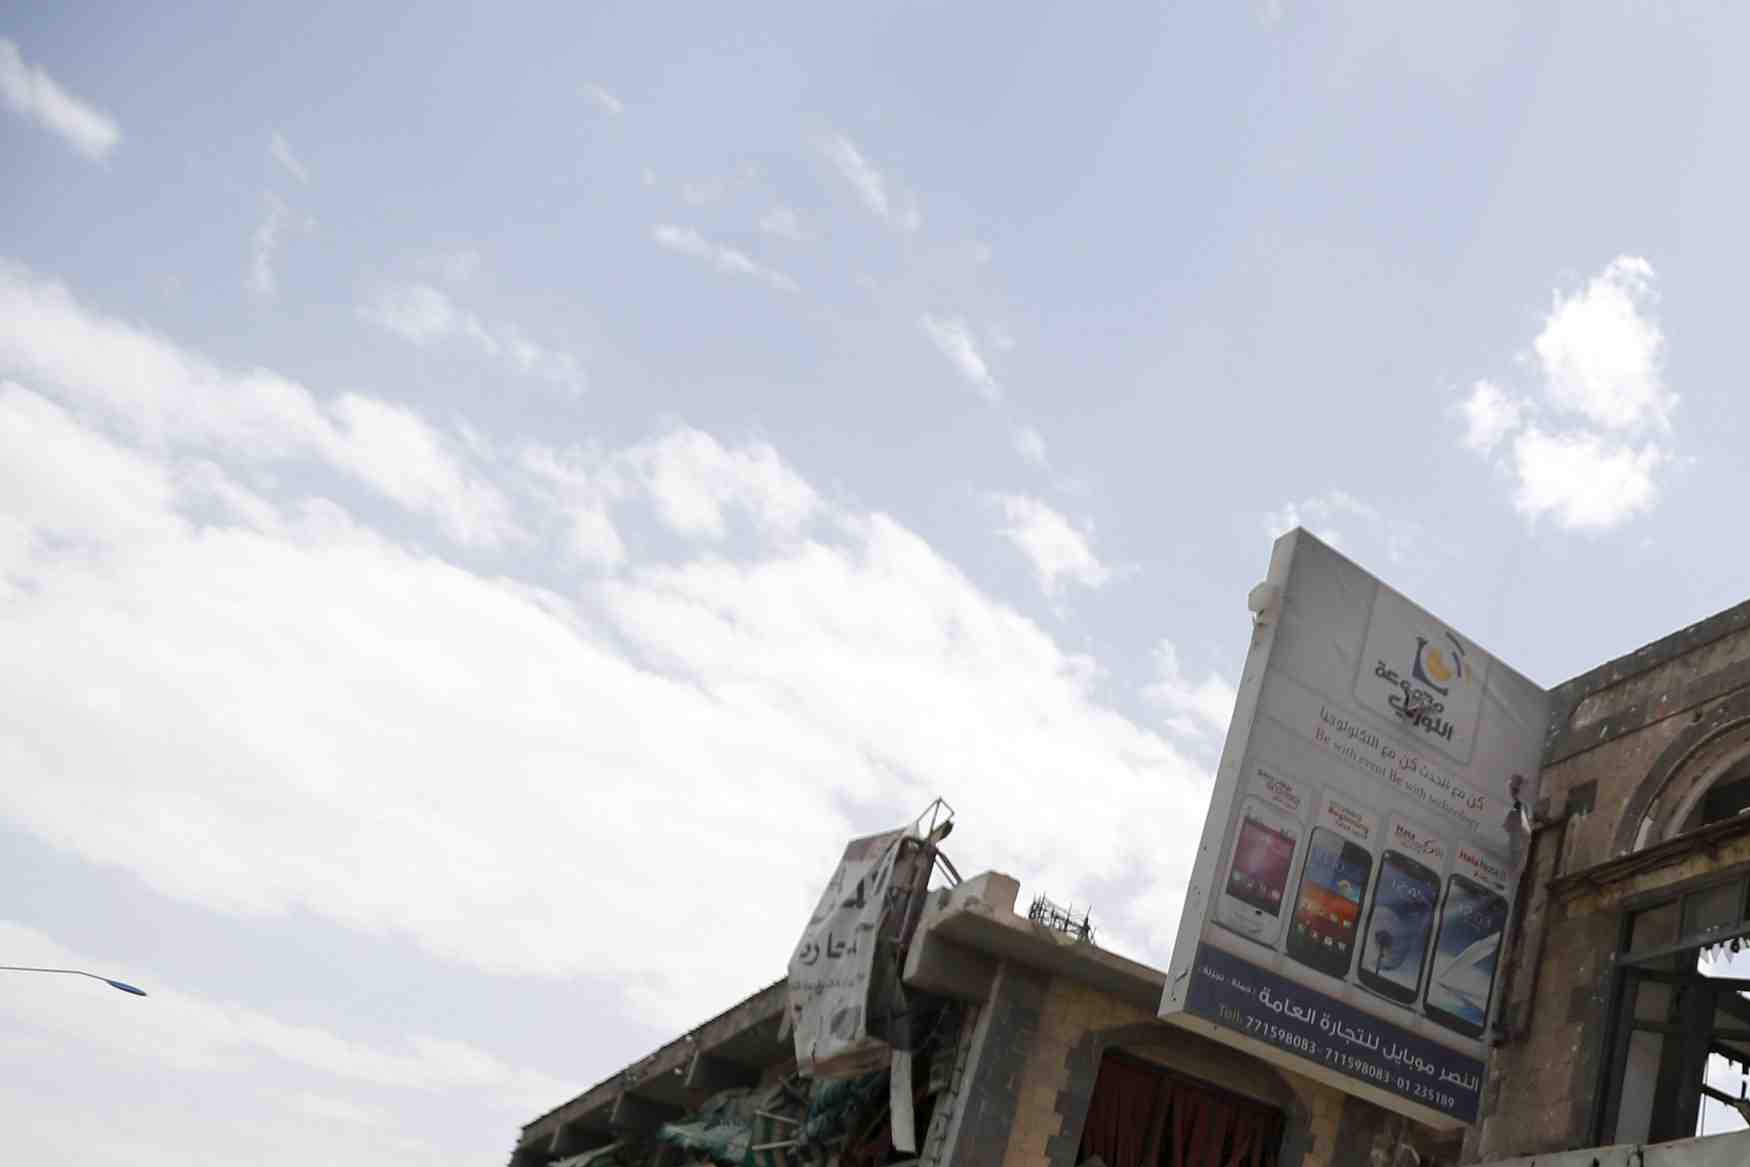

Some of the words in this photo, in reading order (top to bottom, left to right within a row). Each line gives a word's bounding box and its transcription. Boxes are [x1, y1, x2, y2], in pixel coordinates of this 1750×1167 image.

[1258, 986, 1317, 1025] العامة
[1320, 1012, 1380, 1049] للتجارة
[1383, 1043, 1435, 1075] موبايل
[1438, 1067, 1480, 1092] النصر
